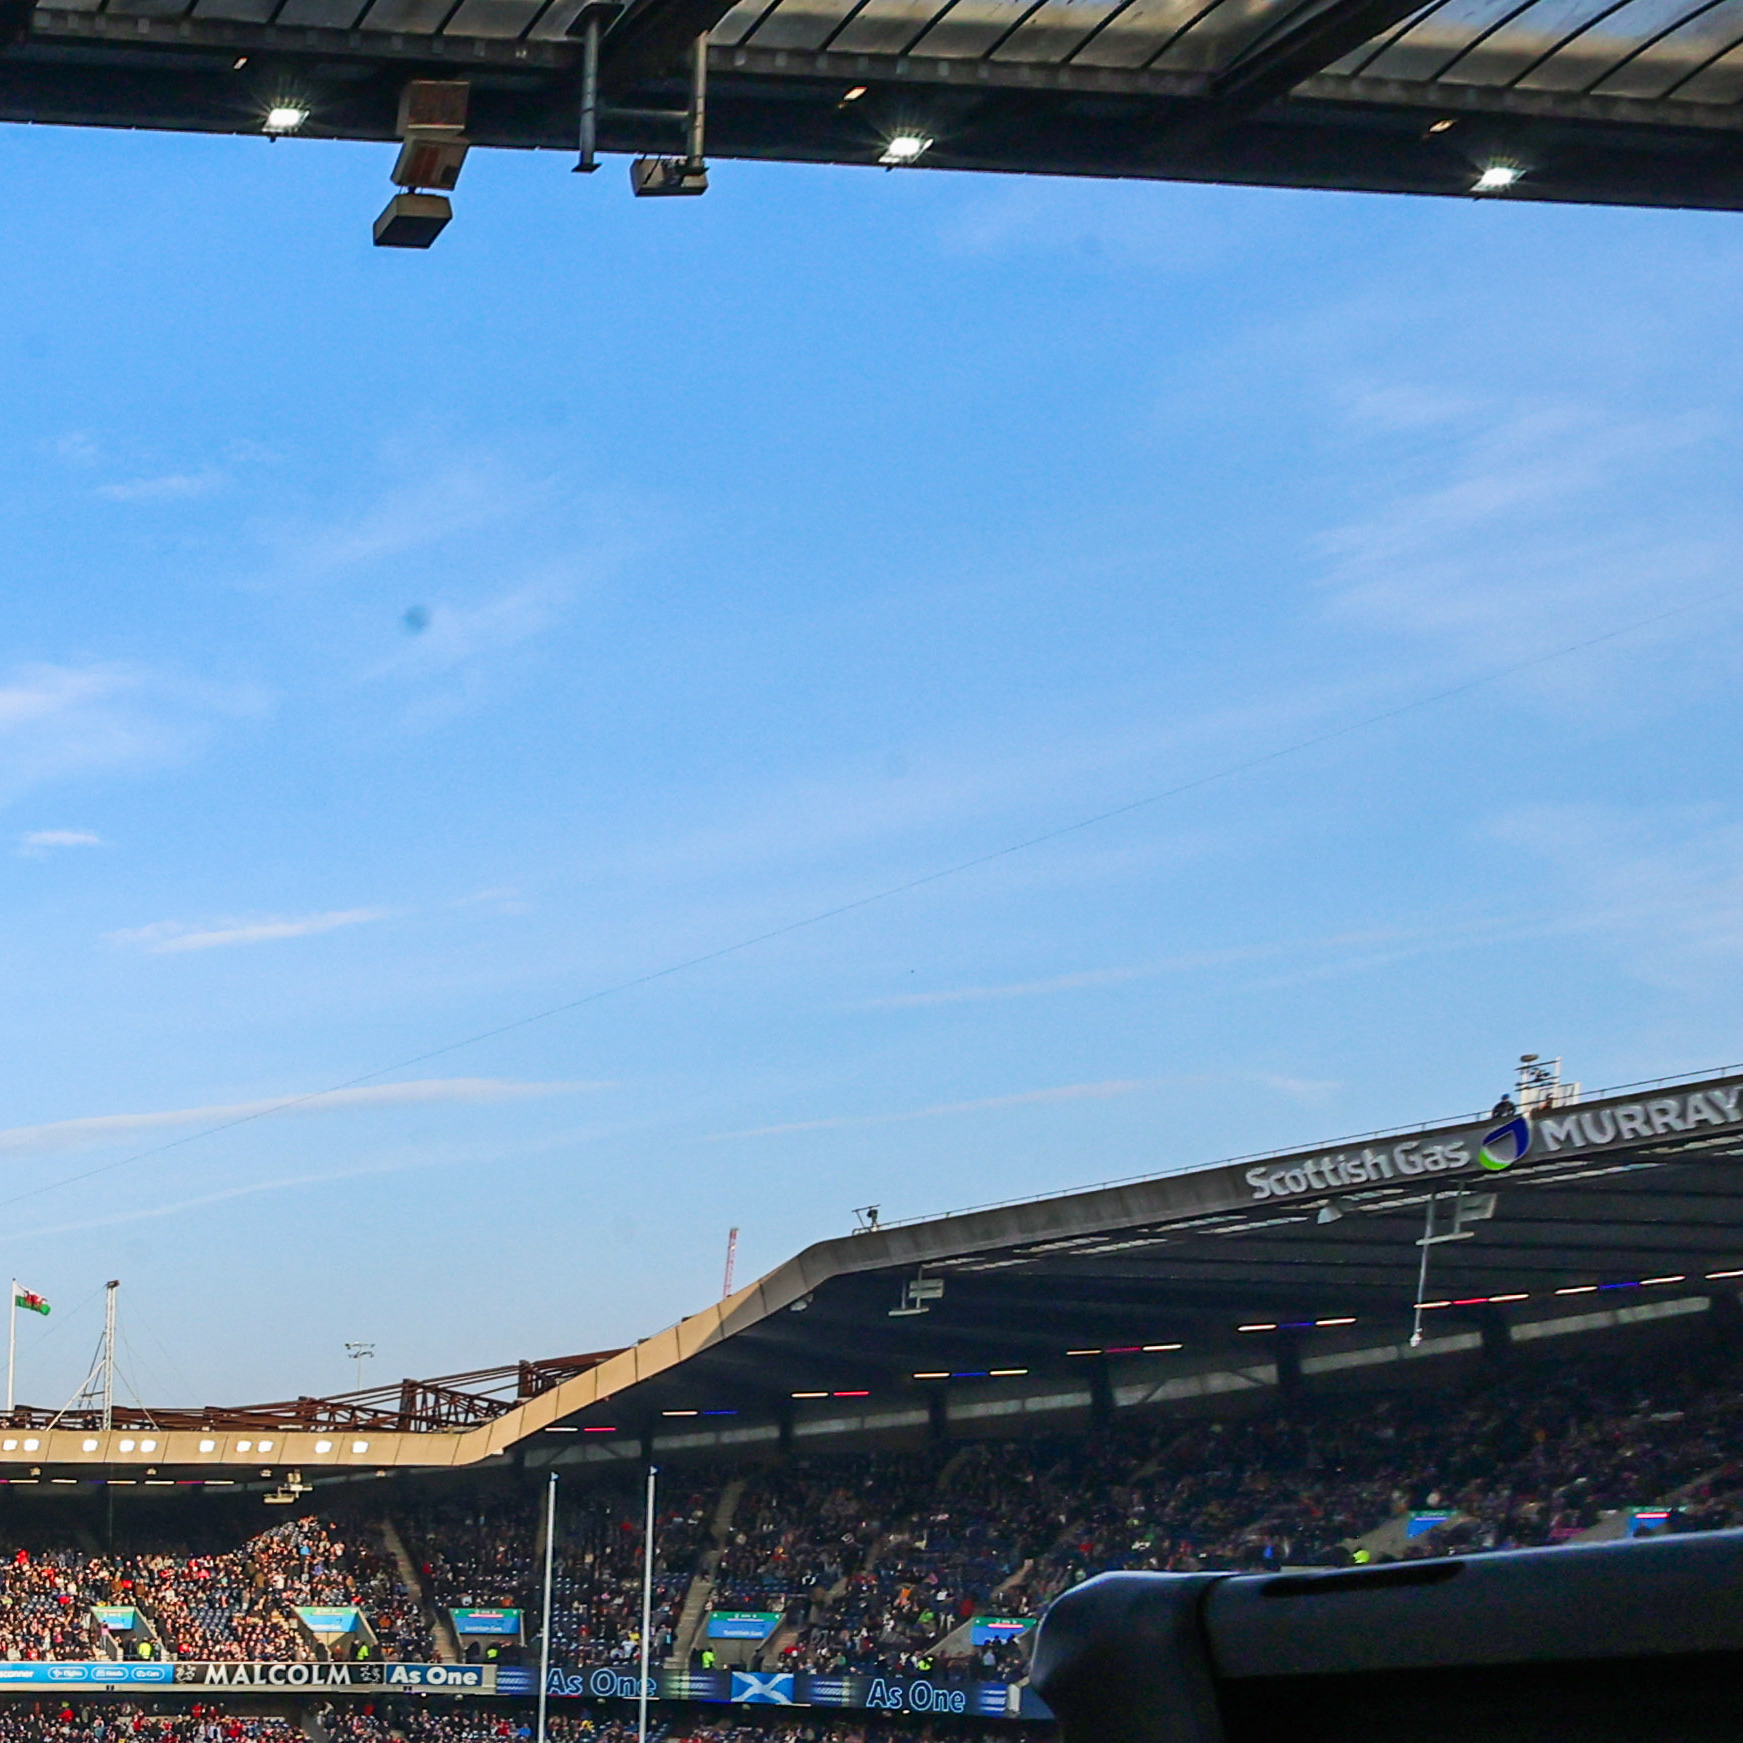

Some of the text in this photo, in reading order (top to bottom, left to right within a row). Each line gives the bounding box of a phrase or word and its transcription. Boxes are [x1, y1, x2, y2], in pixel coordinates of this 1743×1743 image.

[1245, 1138, 1470, 1200] Scottish Gas
[204, 1663, 352, 1685] MALCOLM
[390, 1665, 479, 1685] As One
[547, 1668, 657, 1698] As One
[866, 1679, 965, 1713] As One
